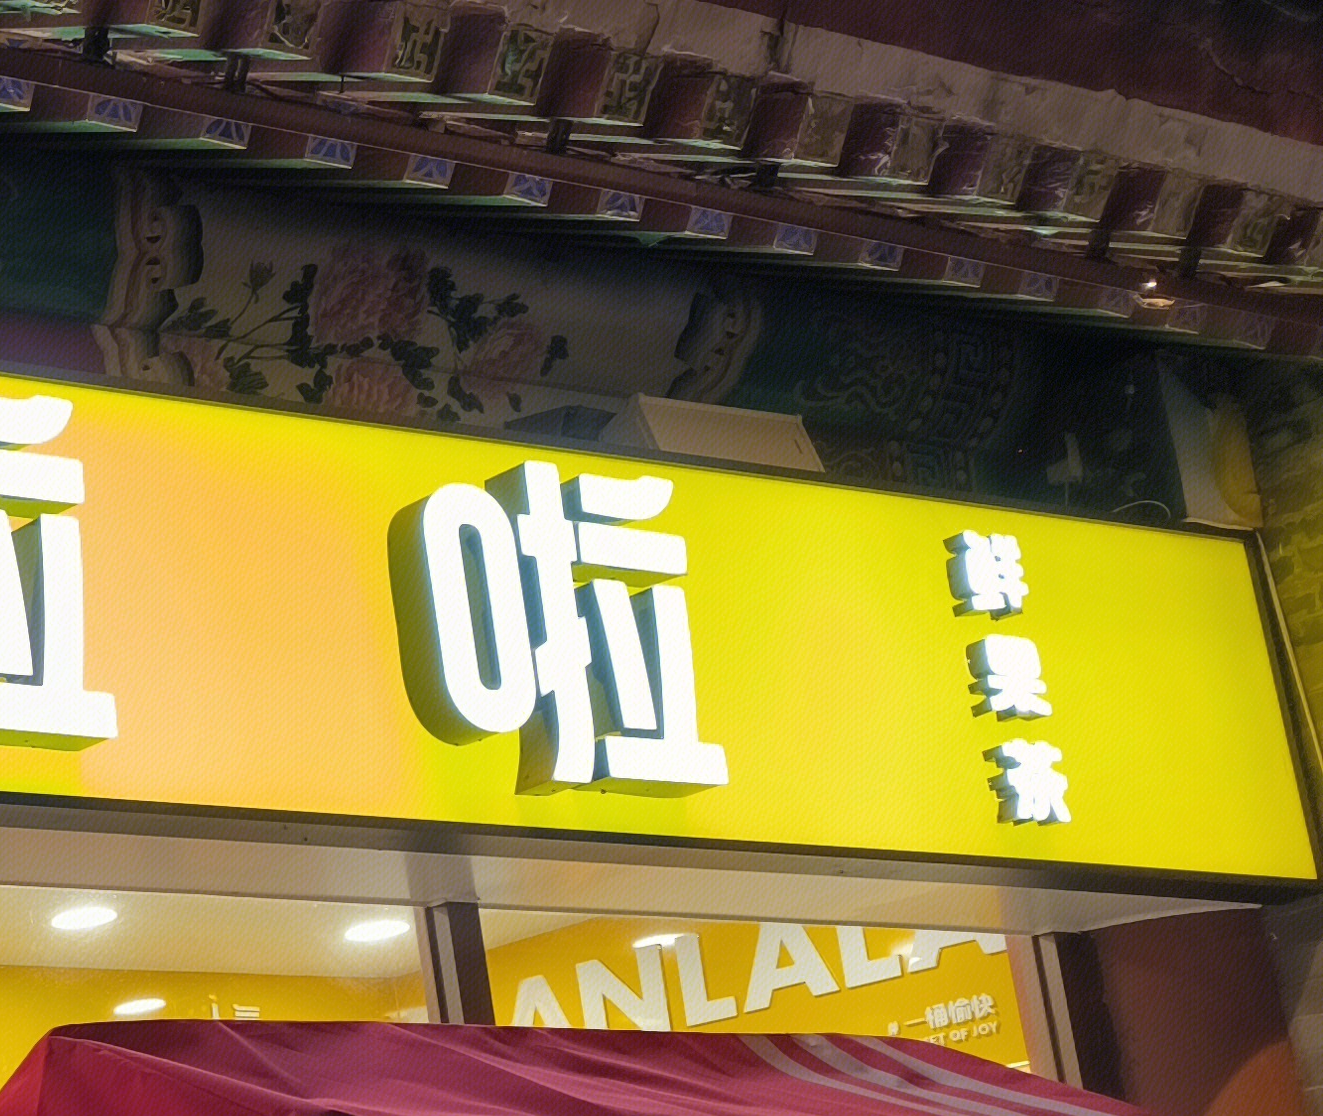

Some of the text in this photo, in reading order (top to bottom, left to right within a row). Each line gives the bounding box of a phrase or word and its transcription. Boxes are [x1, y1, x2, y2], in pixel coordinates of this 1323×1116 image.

[943, 530, 1072, 825] 鲜果茶
[949, 1028, 969, 1042] OF
[972, 1021, 998, 1037] JOY
